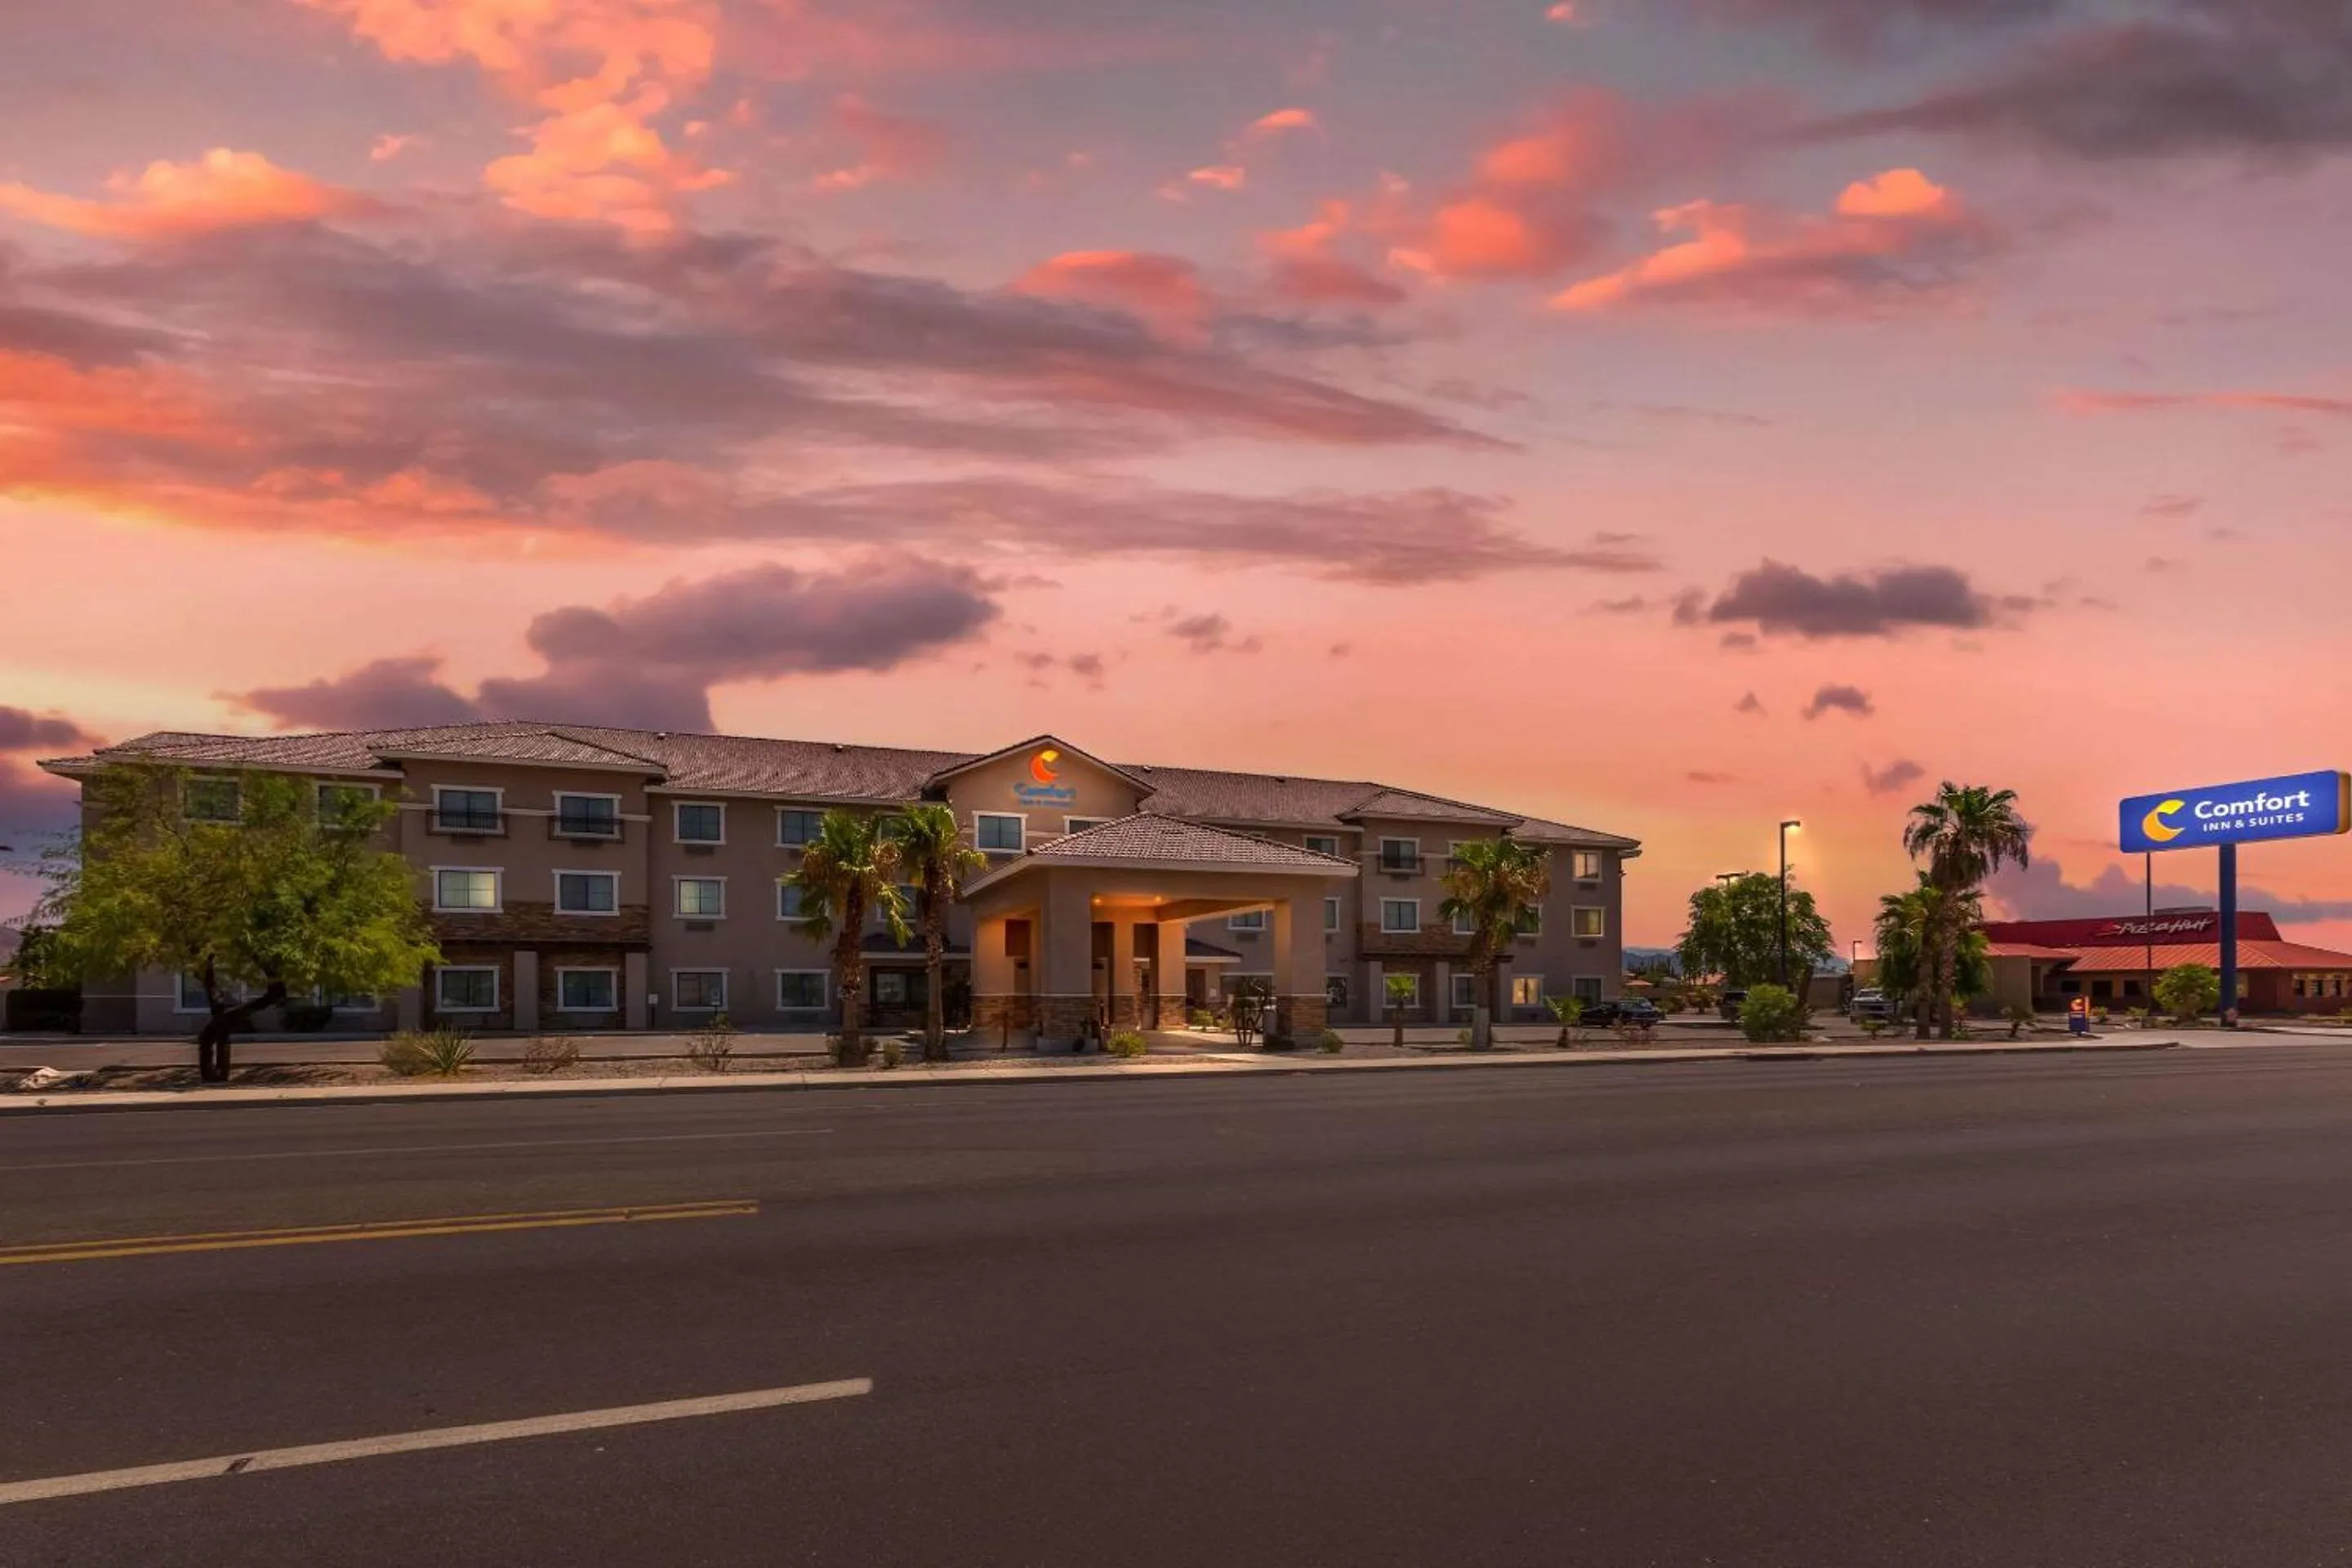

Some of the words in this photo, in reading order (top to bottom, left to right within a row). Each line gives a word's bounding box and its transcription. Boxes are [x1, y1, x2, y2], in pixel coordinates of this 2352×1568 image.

[2194, 790, 2310, 818] Comfort
[2203, 820, 2231, 832] INN
[2235, 818, 2245, 828] &
[2249, 813, 2305, 826] SUITES
